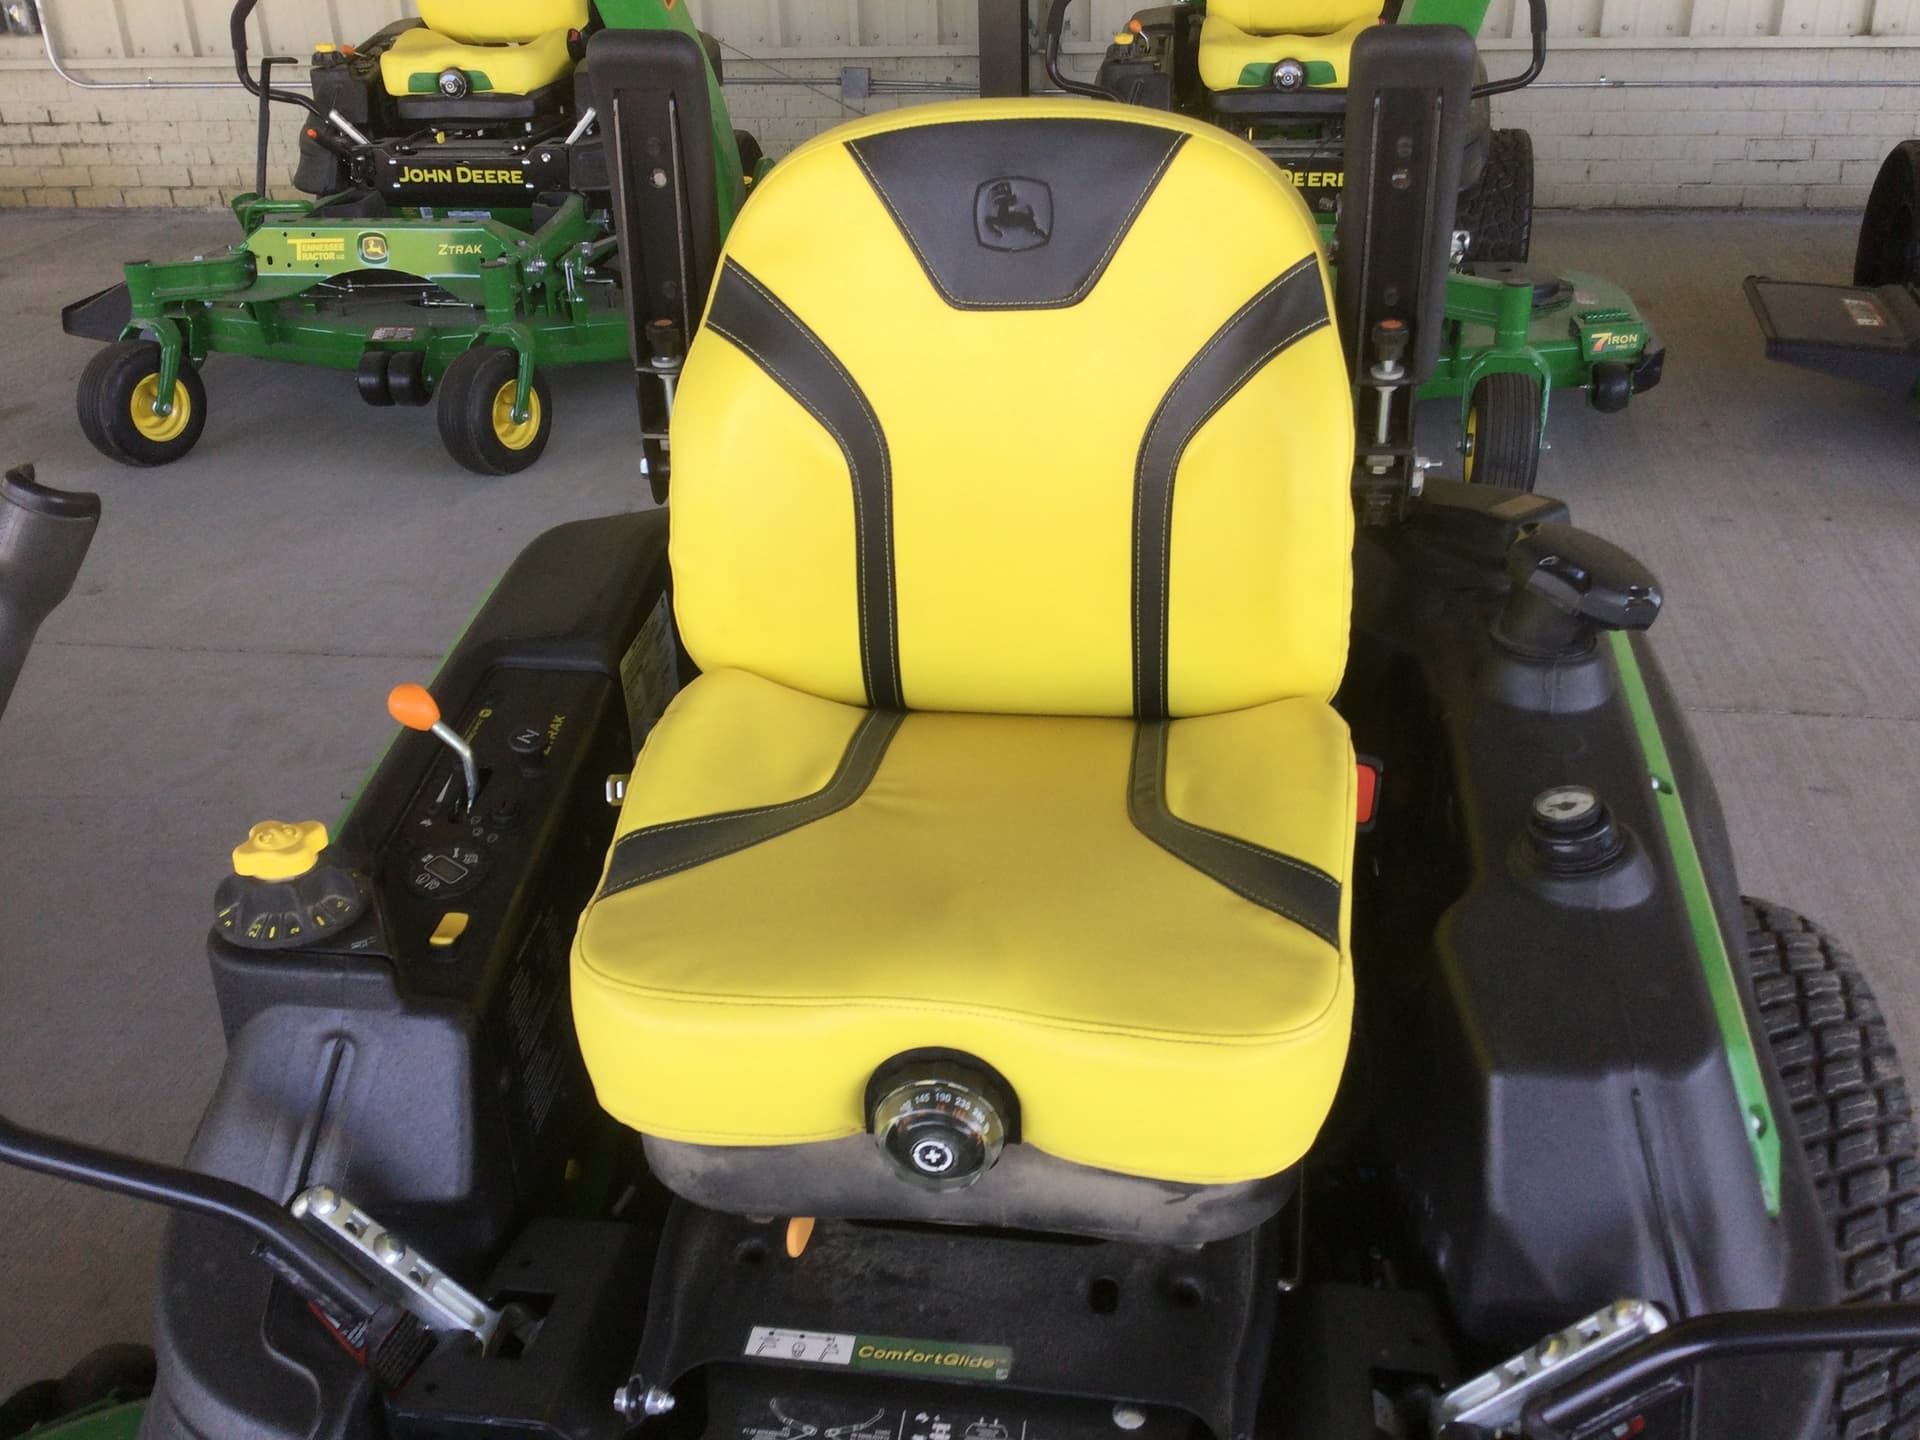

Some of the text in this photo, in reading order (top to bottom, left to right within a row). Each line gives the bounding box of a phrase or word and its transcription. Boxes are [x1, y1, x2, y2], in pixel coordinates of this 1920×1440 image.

[399, 165, 524, 184] JOHN DEERE
[438, 244, 482, 255] ZTRAK
[858, 1344, 996, 1370] ComfortGlide
